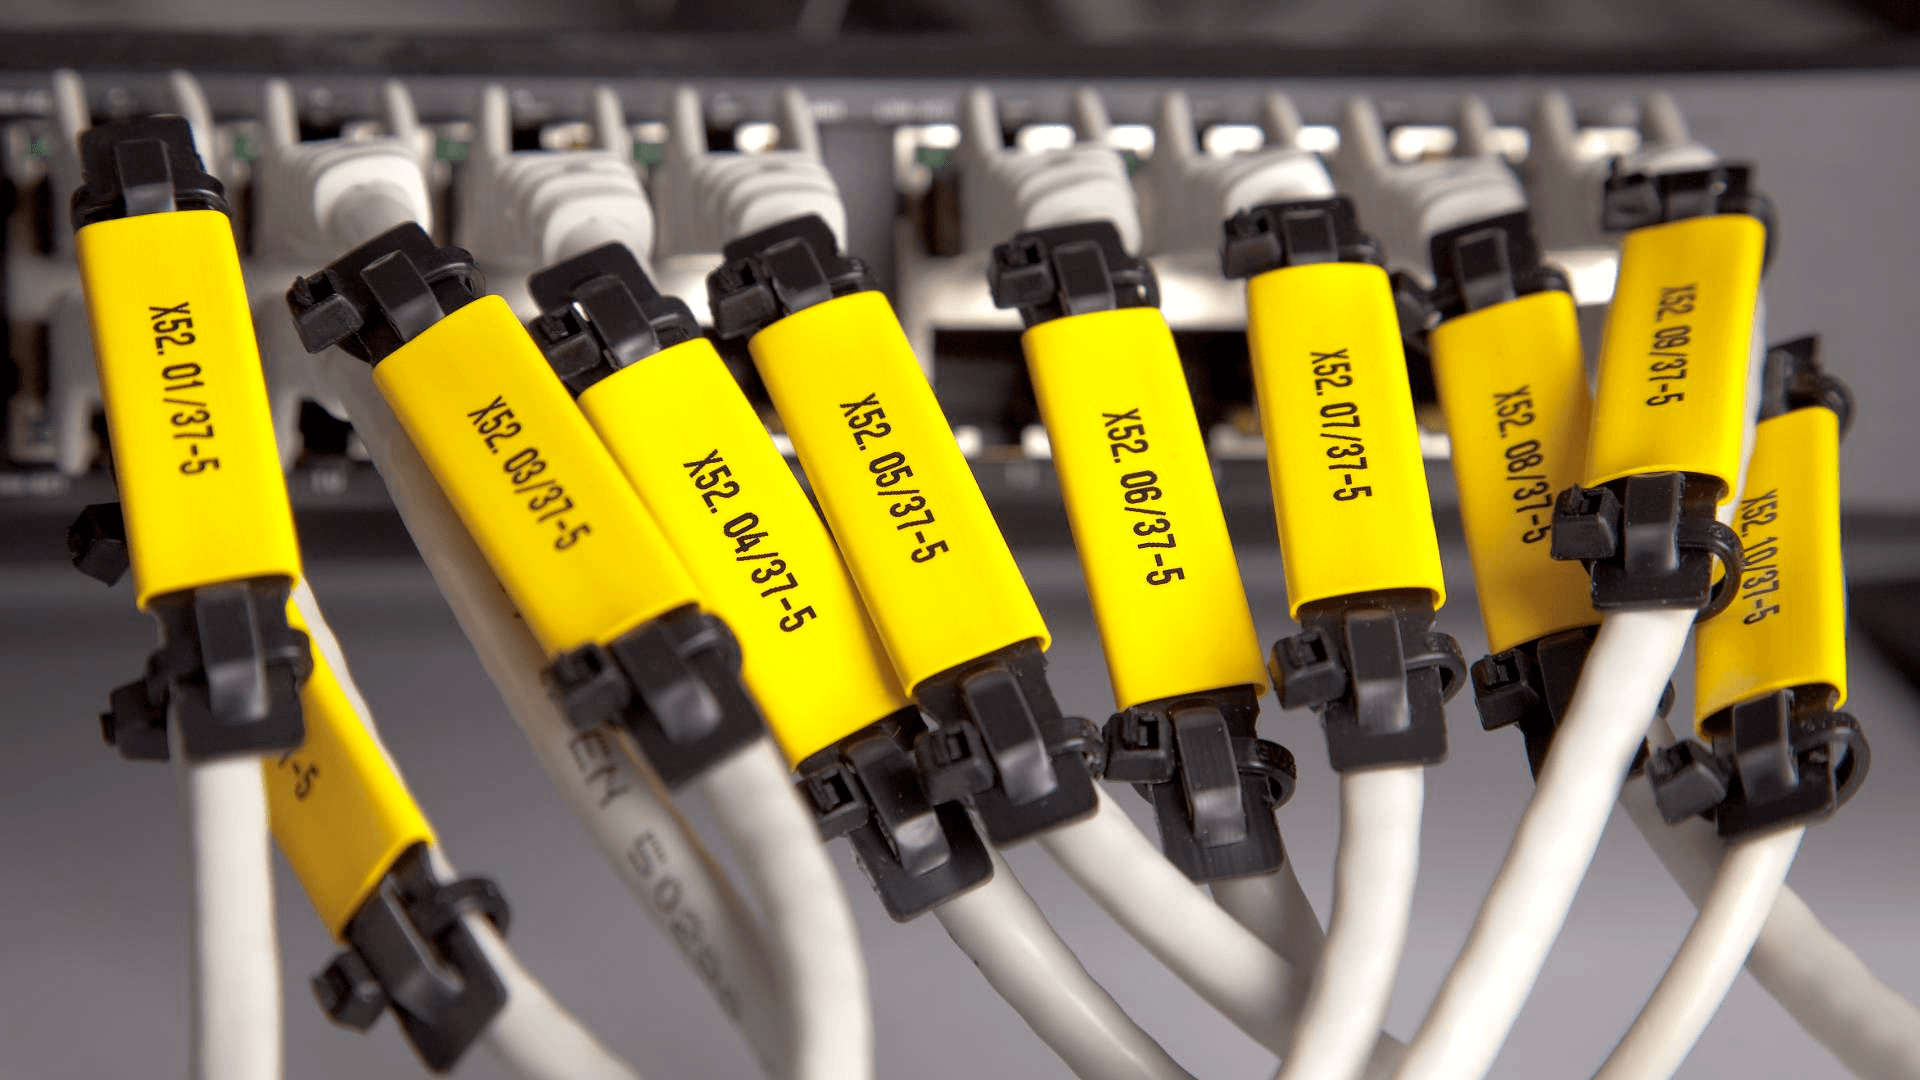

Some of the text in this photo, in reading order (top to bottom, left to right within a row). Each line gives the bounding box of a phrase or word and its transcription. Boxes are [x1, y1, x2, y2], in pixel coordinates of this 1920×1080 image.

[148, 301, 221, 476] X52. 01/37-5
[1645, 283, 1698, 407] X52. 09/37-5
[466, 395, 592, 552] X52. 03/37-5
[839, 392, 950, 564] X52. 05/37-5
[1101, 407, 1186, 587] X52. 06/37-5
[1310, 348, 1374, 502] X52. 07/37-5
[1492, 385, 1553, 545] X52. 08/37-5
[682, 448, 819, 634] X52. 04/37-5
[1742, 488, 1781, 626] X52. 10/37-5
[567, 728, 629, 809] EN
